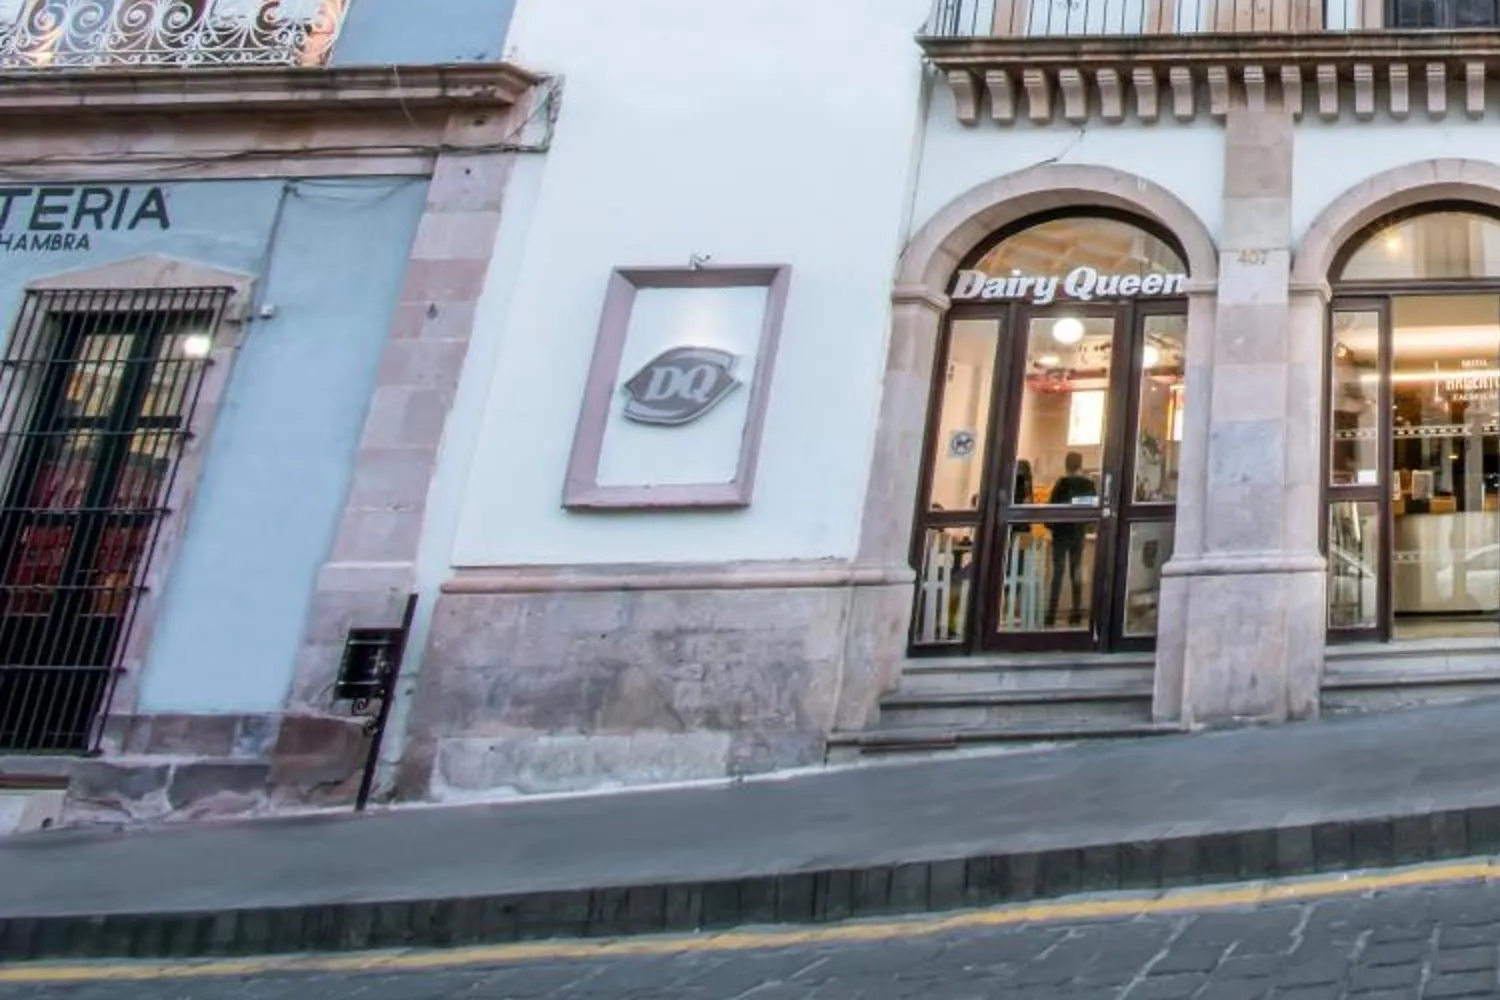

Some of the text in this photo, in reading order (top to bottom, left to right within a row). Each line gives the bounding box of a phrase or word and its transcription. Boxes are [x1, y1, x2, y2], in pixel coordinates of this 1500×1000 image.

[952, 266, 1187, 305] Dairy Queen
[643, 364, 718, 403] DQ
